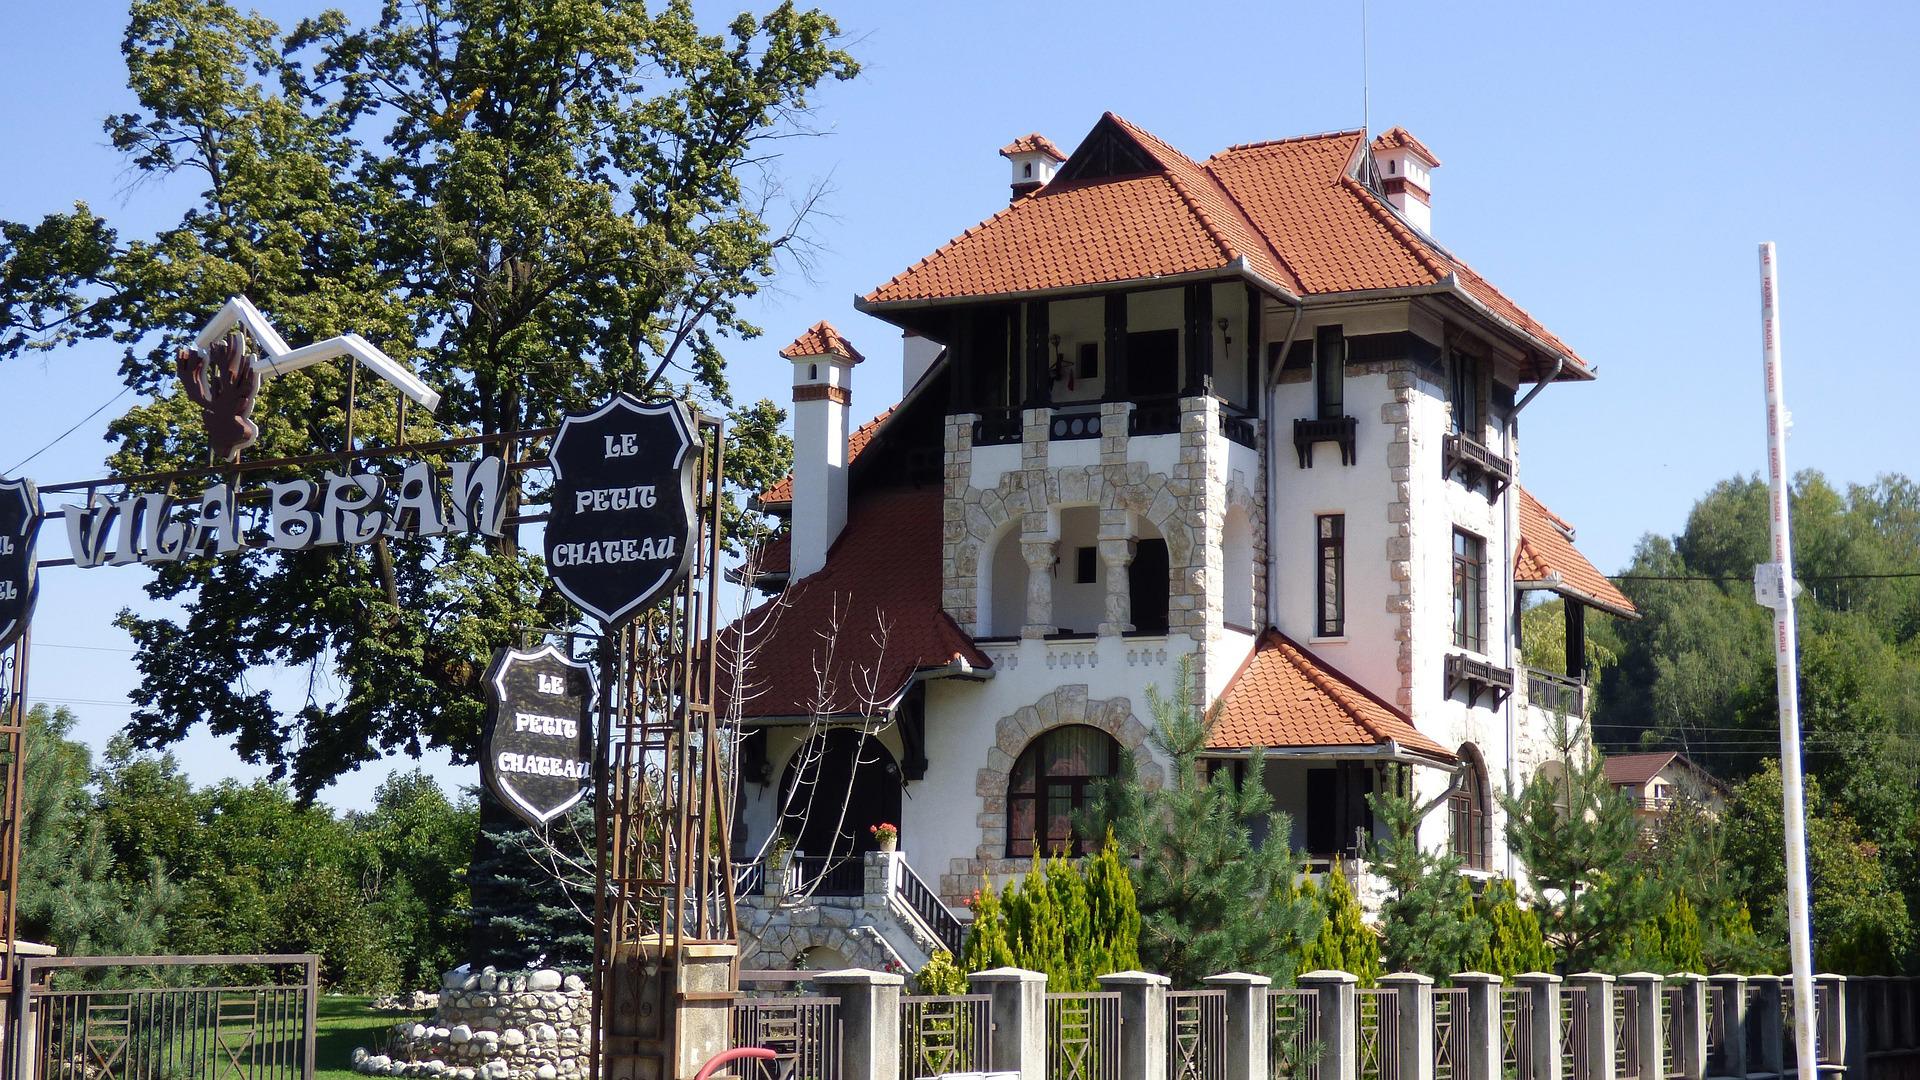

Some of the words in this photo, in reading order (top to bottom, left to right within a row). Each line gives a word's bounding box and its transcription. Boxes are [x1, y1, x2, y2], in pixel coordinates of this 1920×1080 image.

[604, 433, 638, 459] LE
[60, 484, 248, 568] VILA
[267, 456, 507, 550] BRAN
[575, 485, 657, 515] PETIT
[553, 536, 677, 567] CHATEAU
[538, 673, 564, 695] LE
[515, 712, 578, 739] PETIT
[498, 751, 591, 780] CHATEAU
